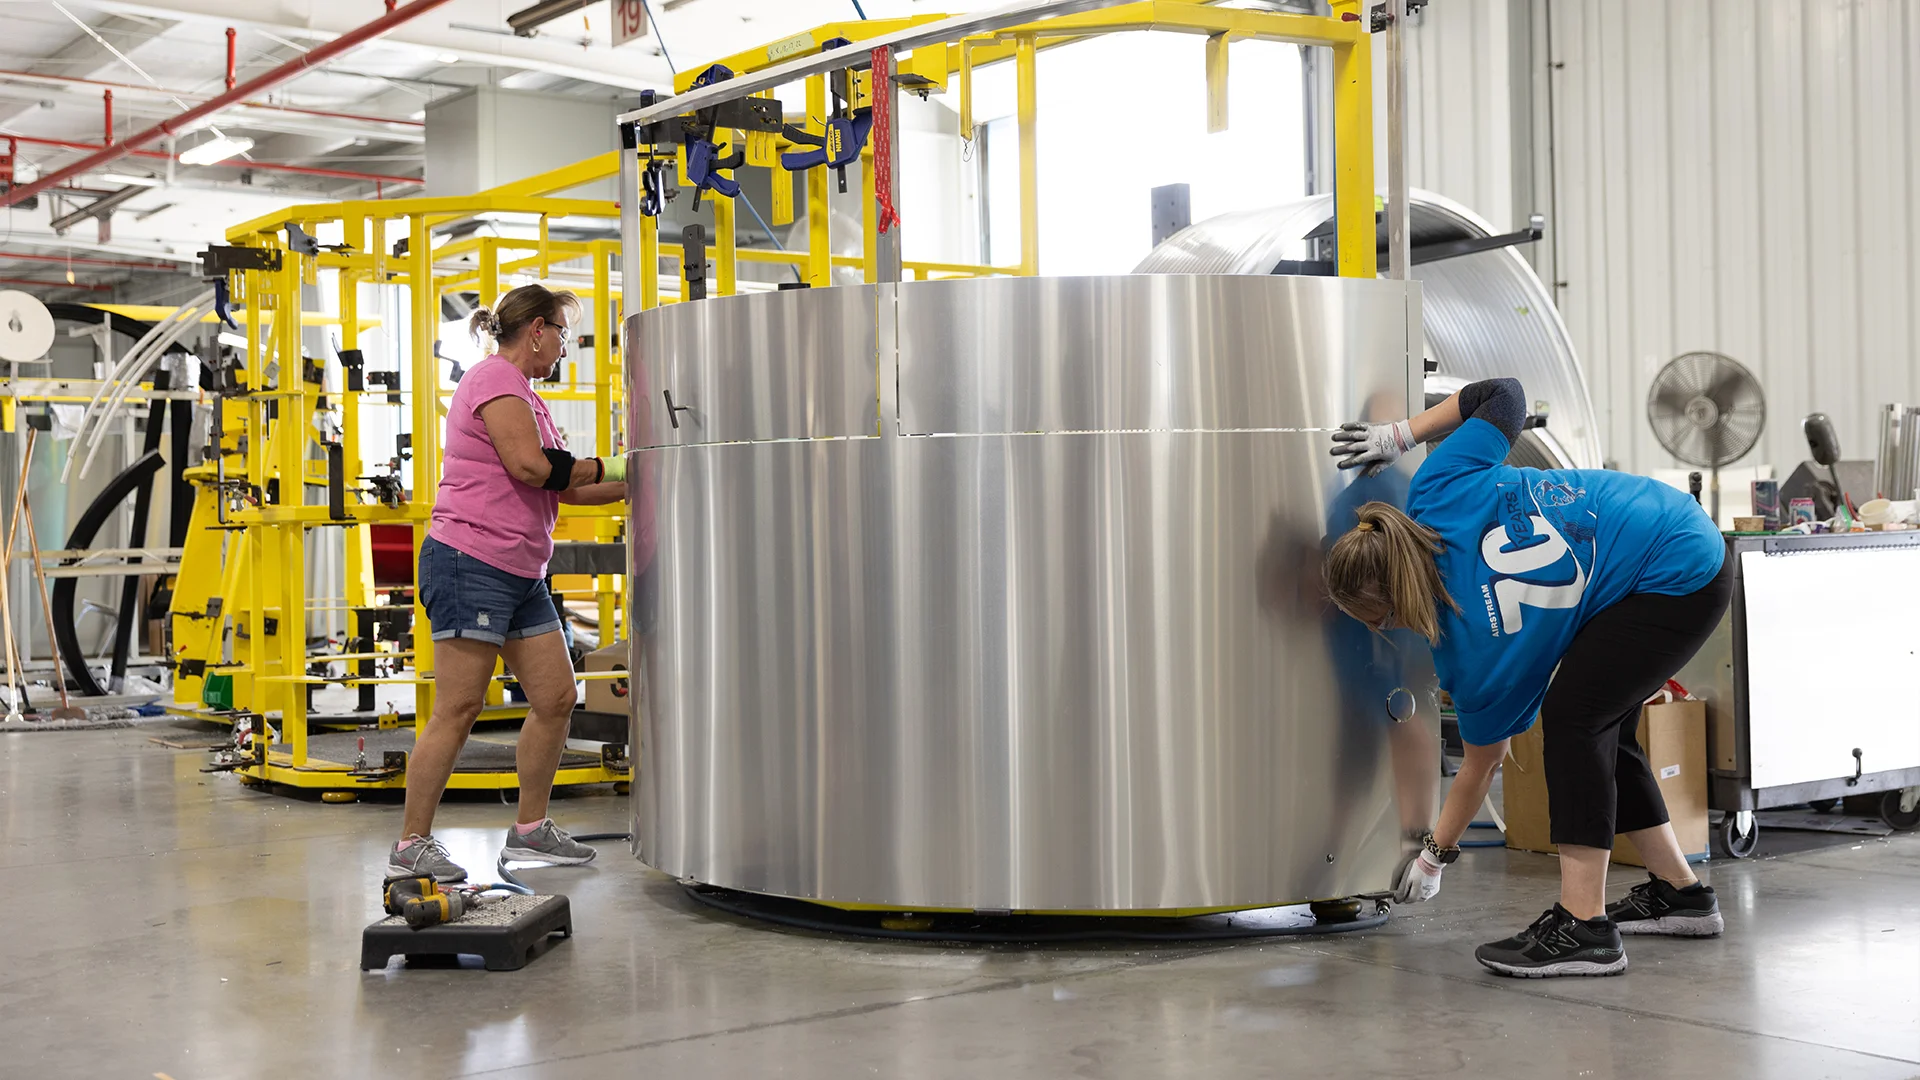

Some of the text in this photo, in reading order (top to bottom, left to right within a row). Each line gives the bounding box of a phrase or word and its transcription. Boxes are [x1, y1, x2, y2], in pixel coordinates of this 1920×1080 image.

[617, 0, 641, 38] 19
[834, 129, 842, 152] IRWIN
[1505, 491, 1530, 547] YEARS
[1481, 584, 1500, 637] AIRSTREAM
